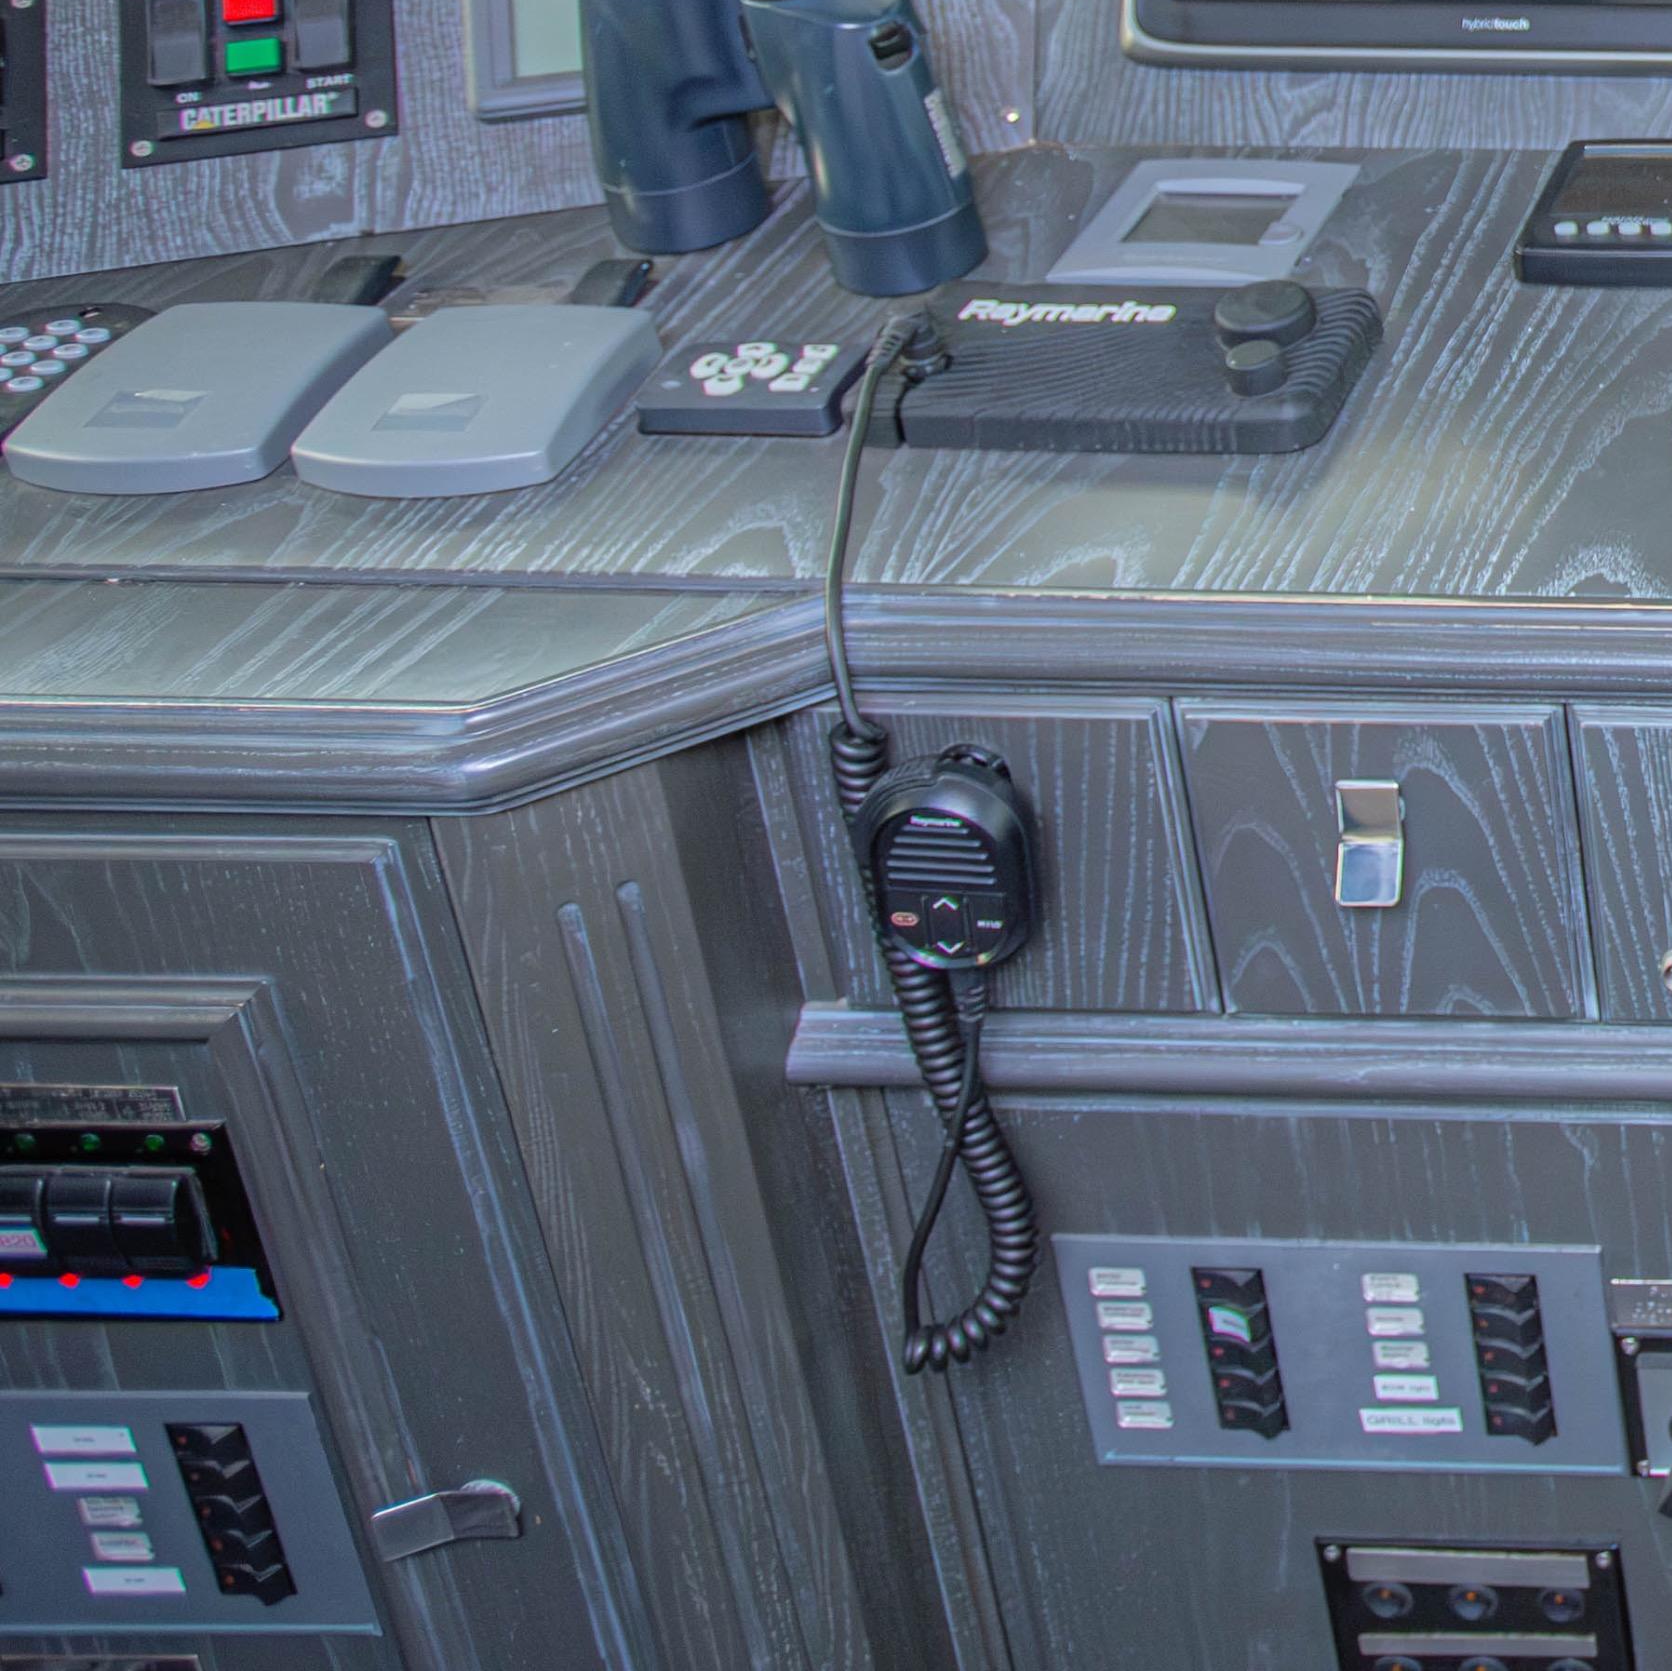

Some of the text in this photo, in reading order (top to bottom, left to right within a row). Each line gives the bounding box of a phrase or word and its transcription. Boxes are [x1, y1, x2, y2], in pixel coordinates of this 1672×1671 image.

[306, 73, 355, 89] START
[180, 93, 332, 130] CATERPILLAR
[957, 298, 1177, 327] Raymarine
